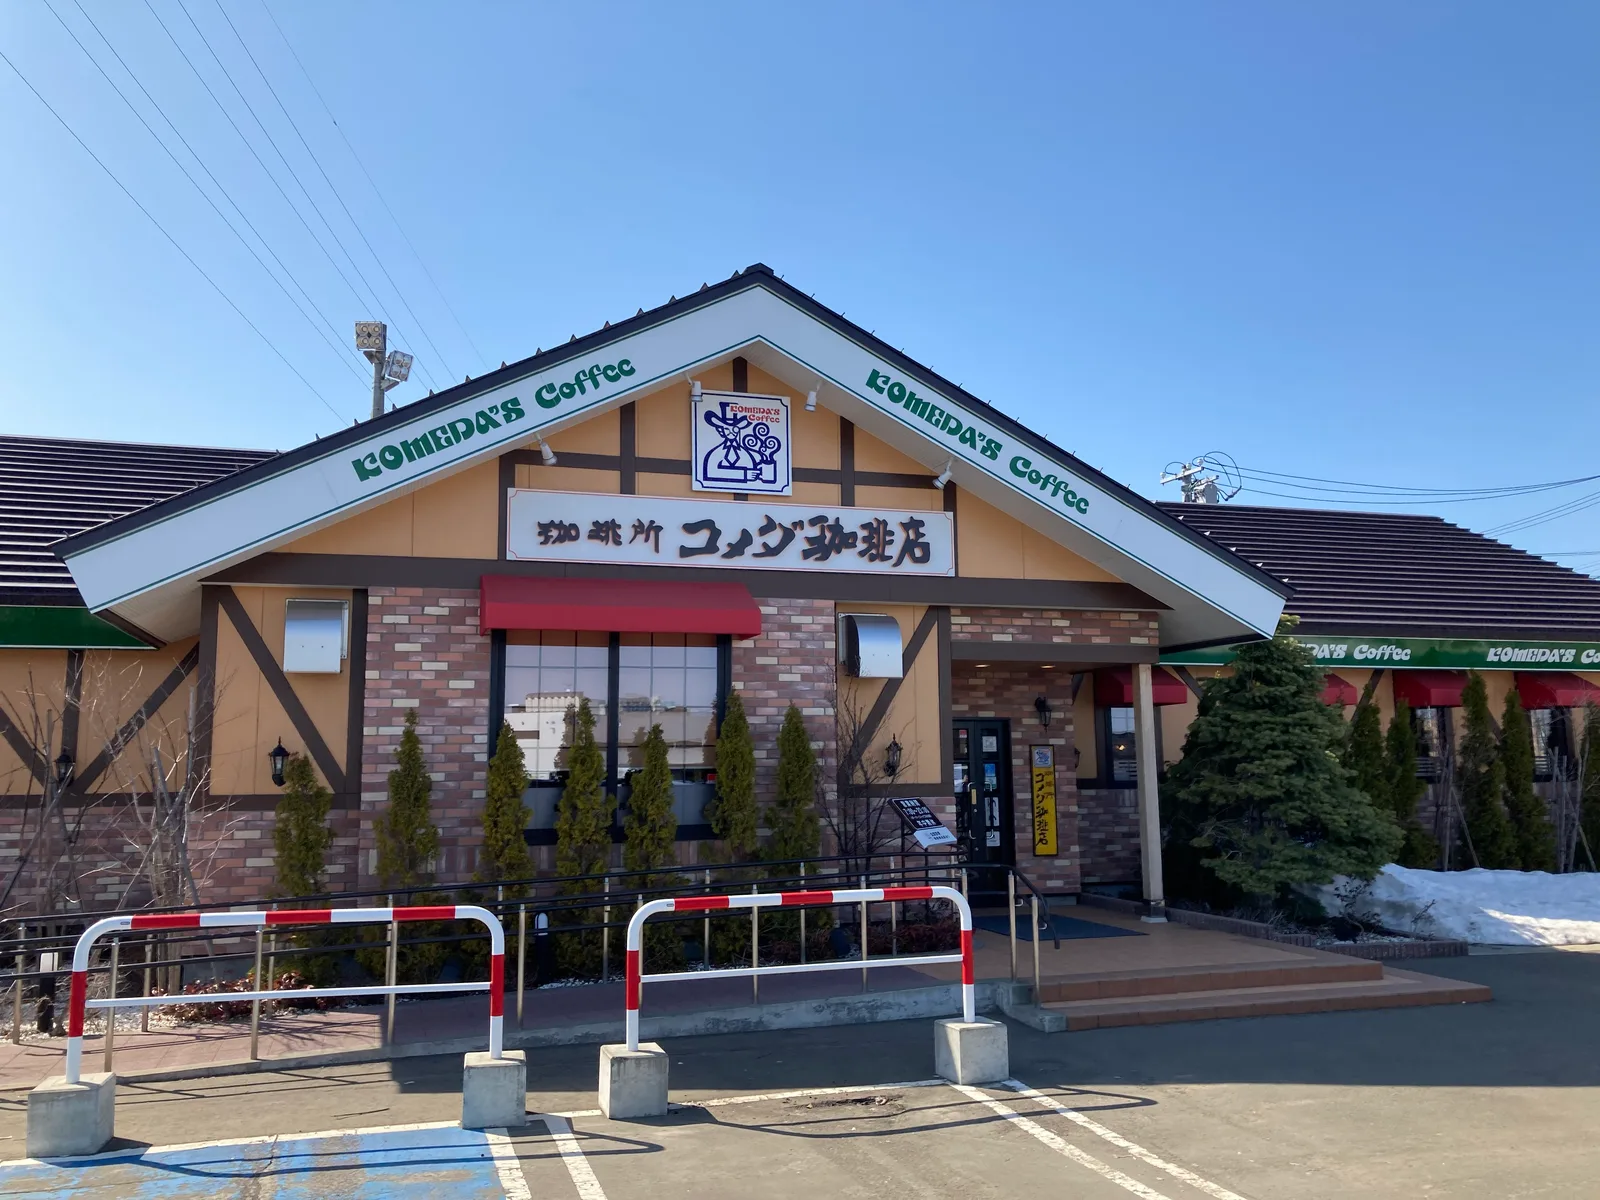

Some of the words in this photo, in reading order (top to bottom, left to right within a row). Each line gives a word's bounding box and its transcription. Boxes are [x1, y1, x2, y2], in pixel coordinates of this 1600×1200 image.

[730, 405, 780, 415] KOMEDA'S
[748, 413, 780, 423] Coffee
[352, 397, 526, 482] KOMEDA'S
[534, 358, 637, 409] Coffee
[865, 368, 1003, 461] KOMEDA'S
[1009, 455, 1090, 514] Coffee
[1353, 644, 1412, 660] Coffee
[1486, 646, 1576, 663] KOMEDA'S
